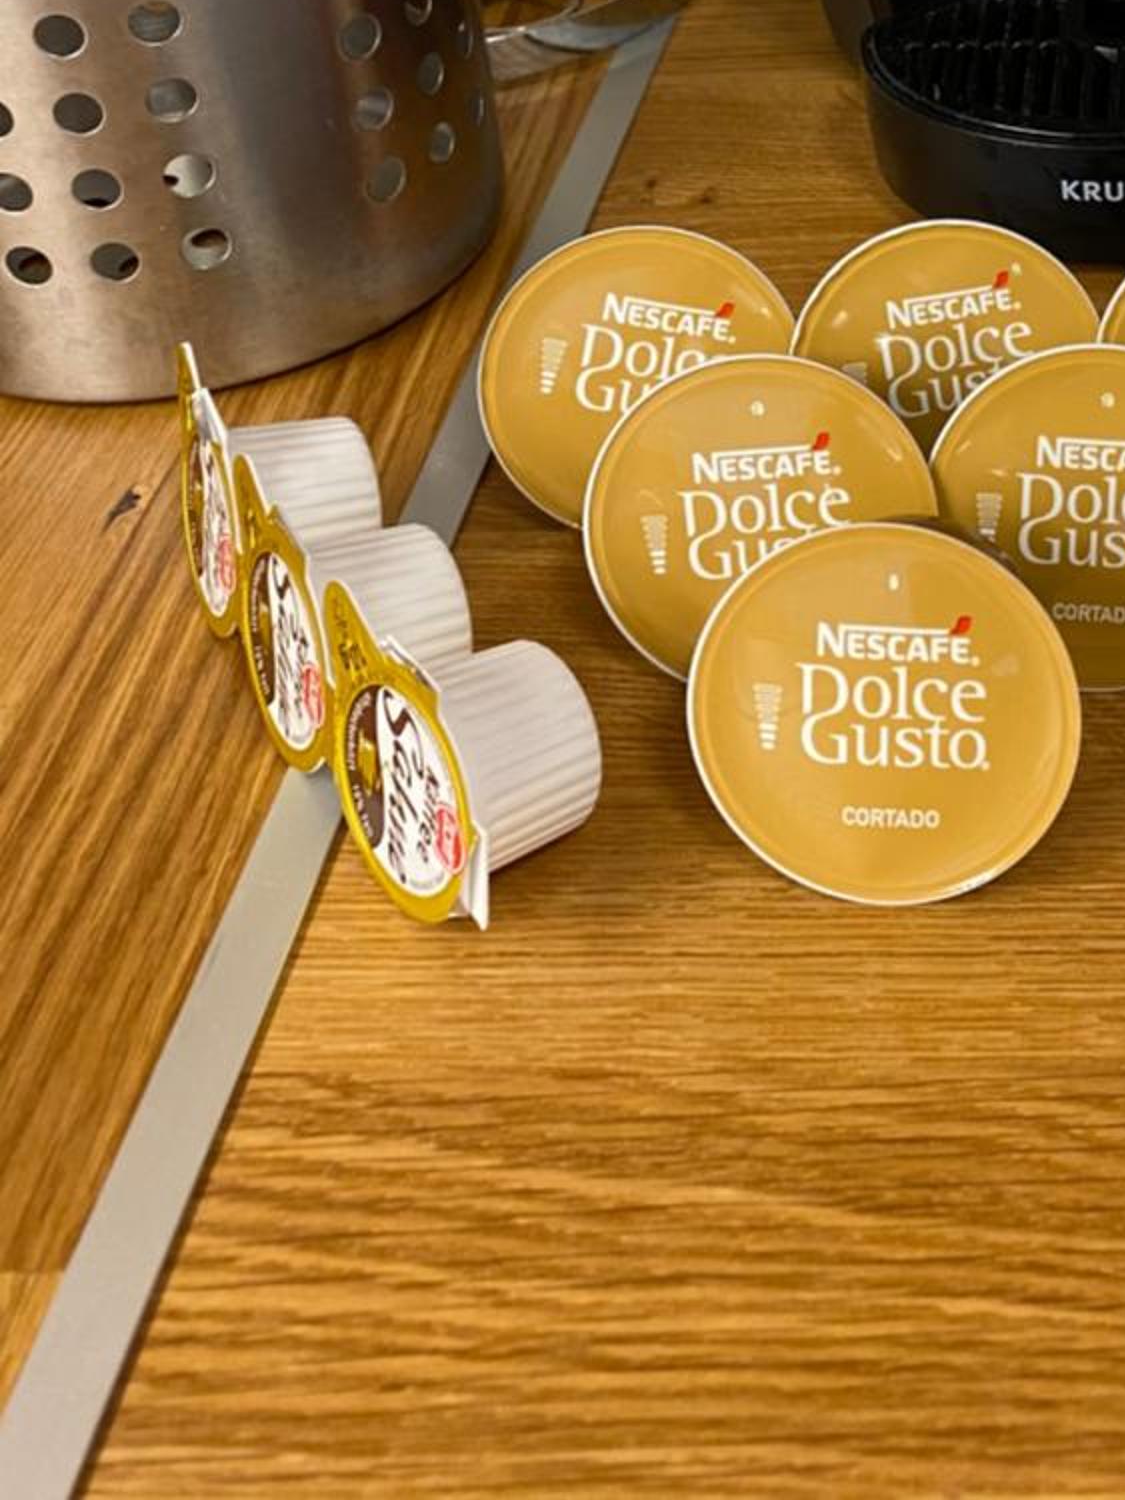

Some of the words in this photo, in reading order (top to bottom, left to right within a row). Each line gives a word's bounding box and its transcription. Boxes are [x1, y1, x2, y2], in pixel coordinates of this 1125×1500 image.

[874, 320, 1035, 382] Dolce
[677, 483, 850, 538] Dolce
[795, 662, 987, 724] Dolce
[841, 805, 941, 830] CORTADO
